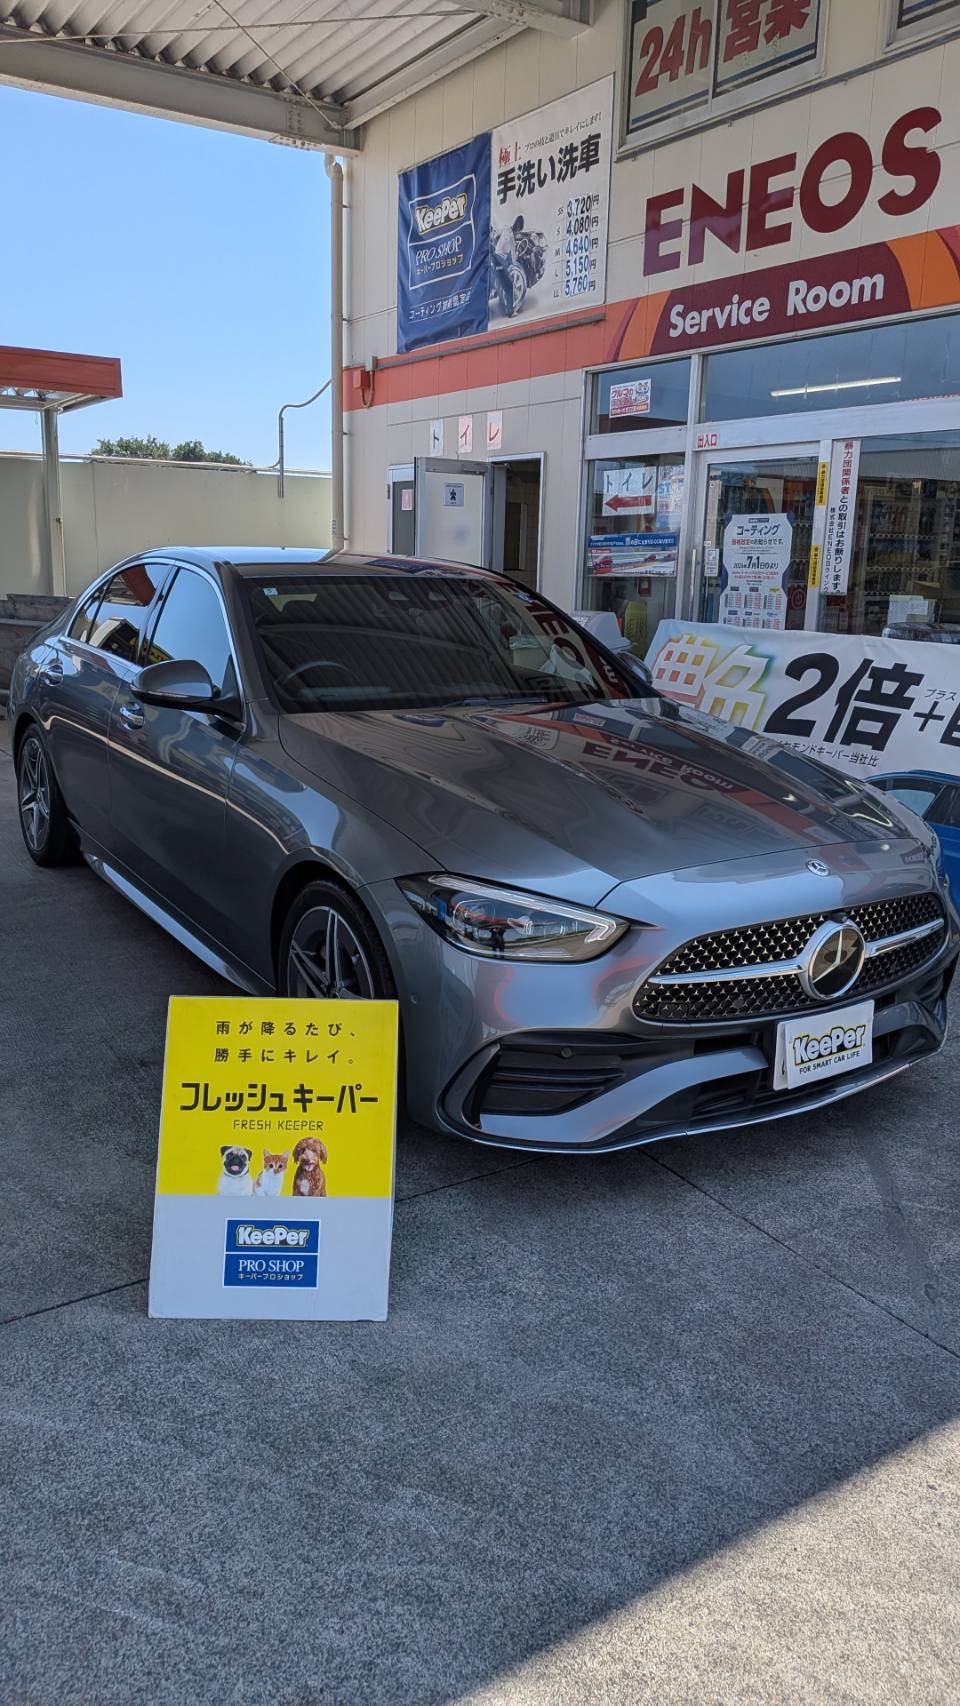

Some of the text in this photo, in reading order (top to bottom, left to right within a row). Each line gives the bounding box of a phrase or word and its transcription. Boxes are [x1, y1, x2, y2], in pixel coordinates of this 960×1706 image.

[497, 133, 601, 204] 手洗い洗車
[643, 107, 942, 277] ENEOS
[415, 194, 467, 235] KeePer
[435, 236, 462, 258] SHOP
[669, 273, 885, 337] Service Room
[433, 421, 500, 449] トイレ
[697, 434, 718, 448] 出入口
[606, 472, 654, 493] トイレ
[832, 441, 853, 594] 暴力団関係者との取引はお断りします。
[736, 523, 781, 536] コーティング
[924, 688, 957, 701] プラス
[216, 1020, 356, 1037] 雨が降るたび、
[214, 1047, 354, 1065] 勝手にキレイ。
[792, 1024, 867, 1066] KeePer
[799, 1050, 861, 1075] FOR SMART CAR LIFE
[180, 1082, 379, 1114] フレッシュキーパー
[233, 1119, 324, 1132] FRESH KEEPER
[237, 1225, 310, 1247] KeePer
[238, 1259, 304, 1273] PRO SHOP
[238, 1273, 303, 1281] キーパープロショップ
